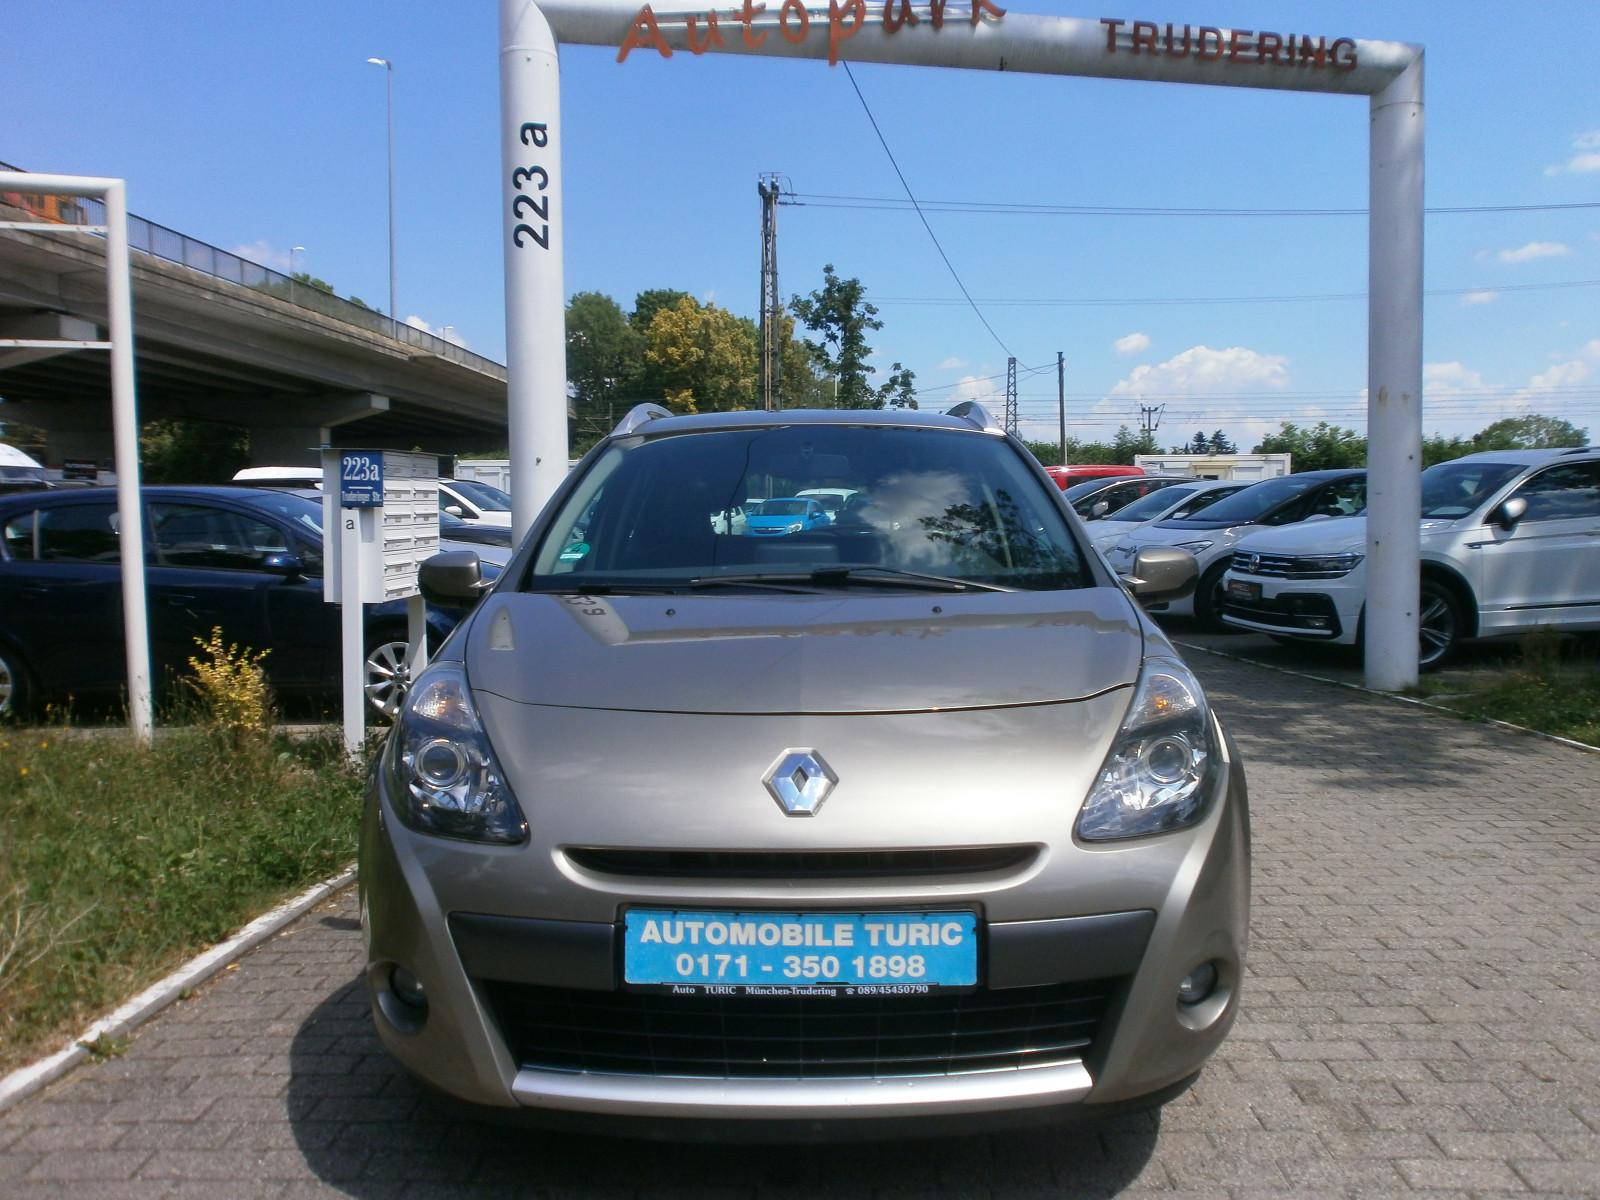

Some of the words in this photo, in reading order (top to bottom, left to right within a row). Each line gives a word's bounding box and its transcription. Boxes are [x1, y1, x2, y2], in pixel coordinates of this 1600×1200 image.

[1100, 17, 1358, 73] TRUDERING
[520, 122, 548, 148] a
[512, 165, 549, 250] 223
[343, 457, 380, 481] 223a
[345, 519, 355, 530] a
[640, 920, 854, 946] AUTOMOBILE
[864, 922, 963, 946] TURIC
[676, 953, 748, 977] 0171
[783, 955, 840, 978] 350
[852, 955, 926, 978] 1898
[672, 985, 696, 995] Auto
[704, 985, 737, 995] TURIC
[745, 986, 837, 997] München-Trudering
[857, 985, 929, 996] 089/45450790
